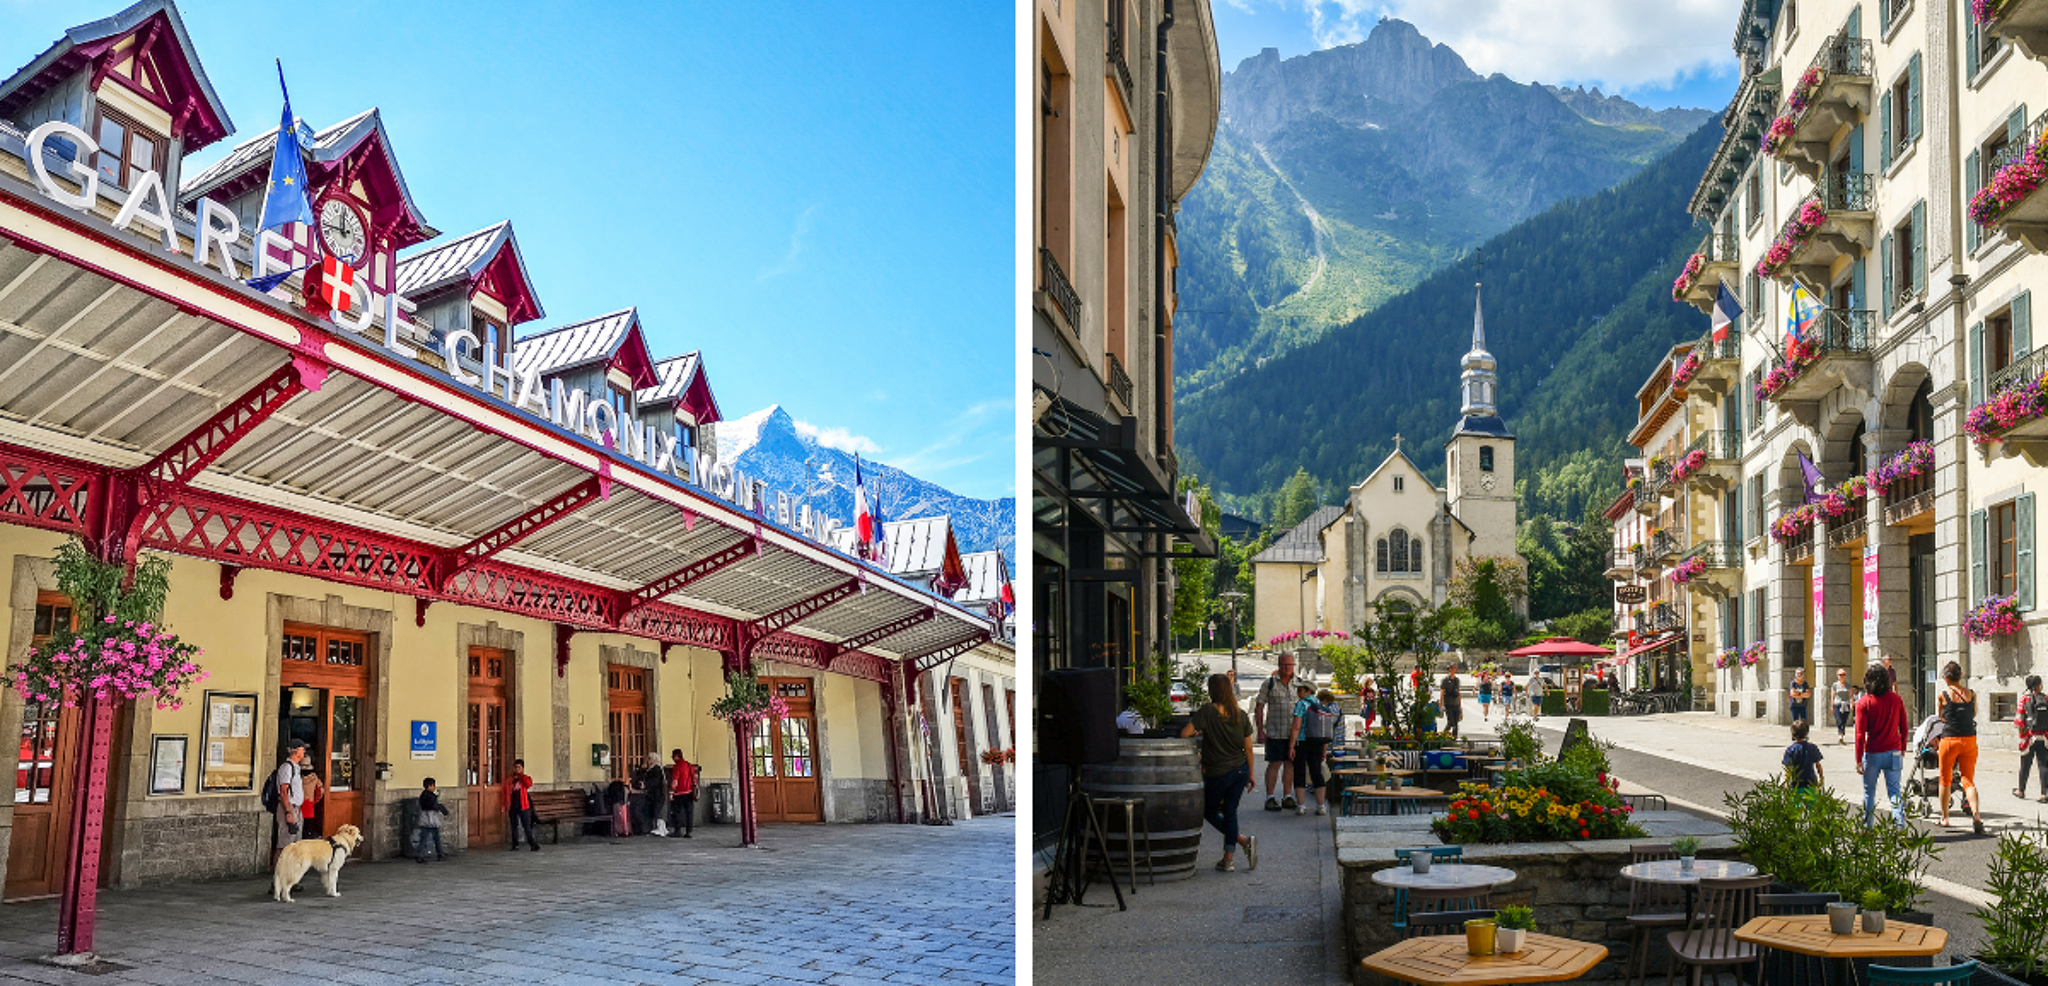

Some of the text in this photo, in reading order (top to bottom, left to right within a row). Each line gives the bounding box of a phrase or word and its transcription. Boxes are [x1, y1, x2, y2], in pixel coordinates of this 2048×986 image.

[24, 121, 294, 303] GARE
[329, 272, 417, 358] DE
[445, 329, 678, 477] CHAMONIX
